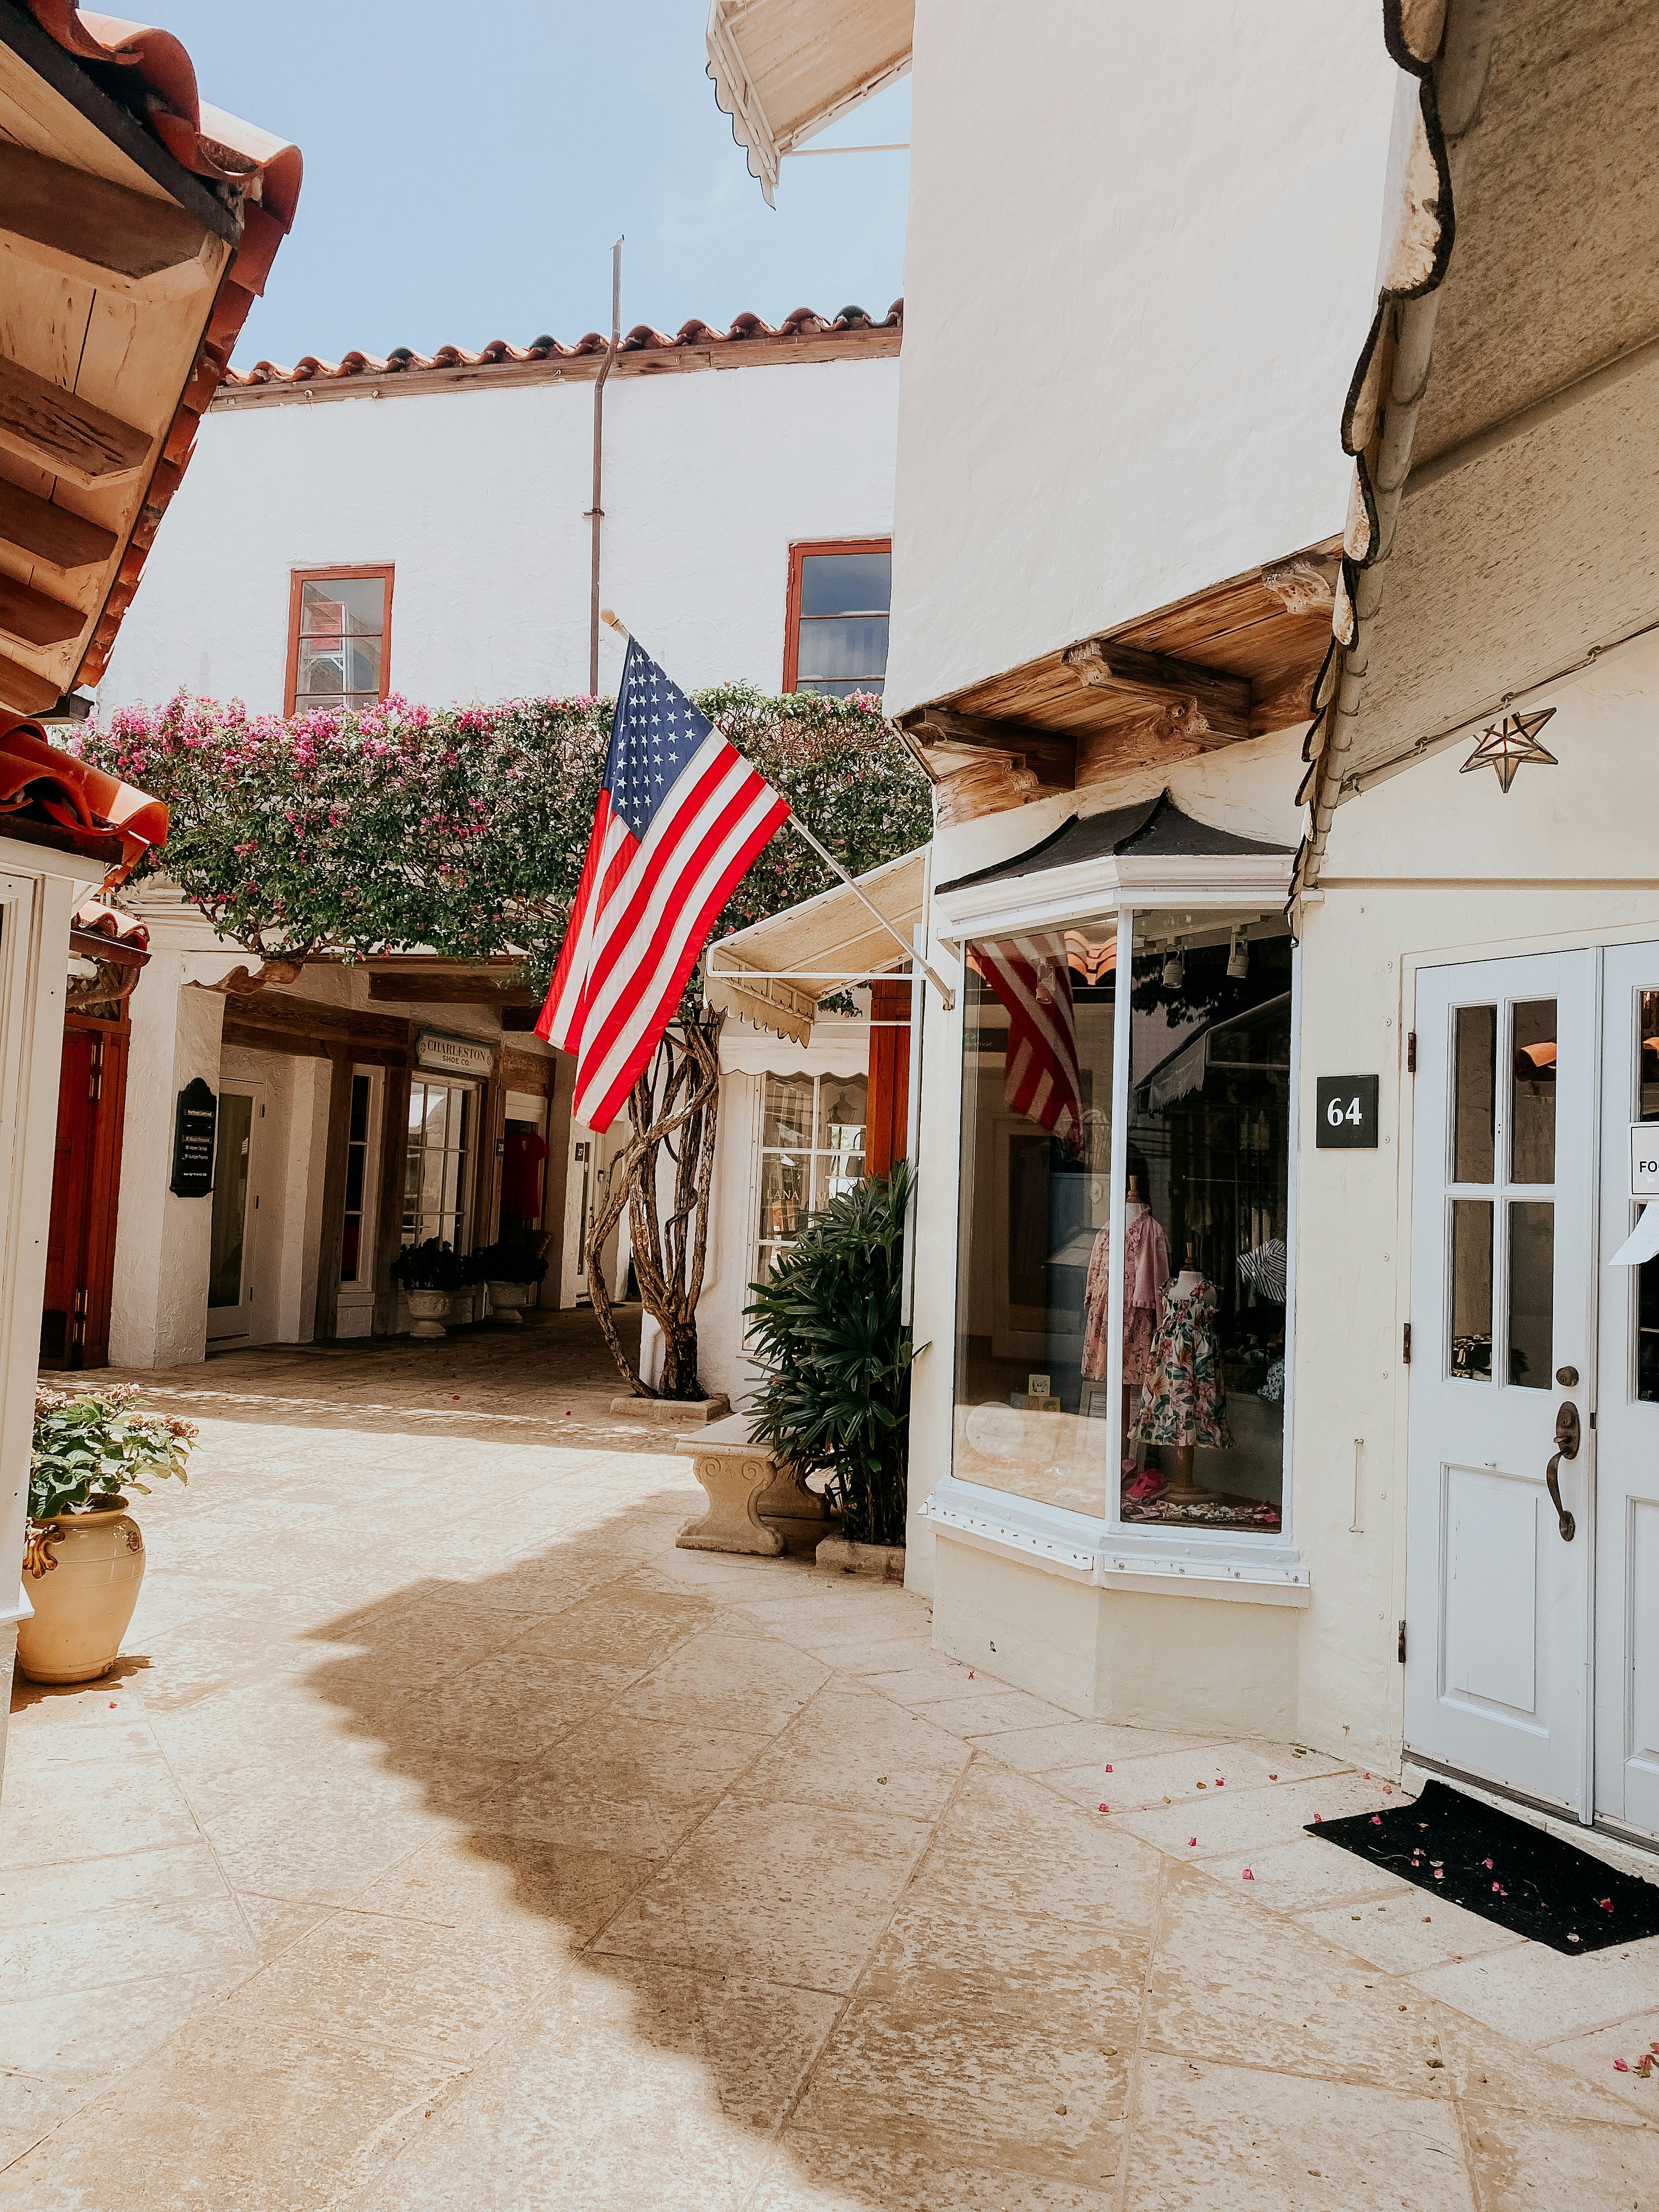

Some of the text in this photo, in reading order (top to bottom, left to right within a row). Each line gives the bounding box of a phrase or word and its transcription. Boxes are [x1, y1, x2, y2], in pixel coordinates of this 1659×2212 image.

[427, 1040, 486, 1061] CHARLESTON
[442, 1055, 471, 1067] SHOE CO.
[1327, 1097, 1363, 1126] 64
[498, 1143, 504, 1152] 28
[1639, 1161, 1659, 1173] FO
[766, 1189, 800, 1201] LANA
